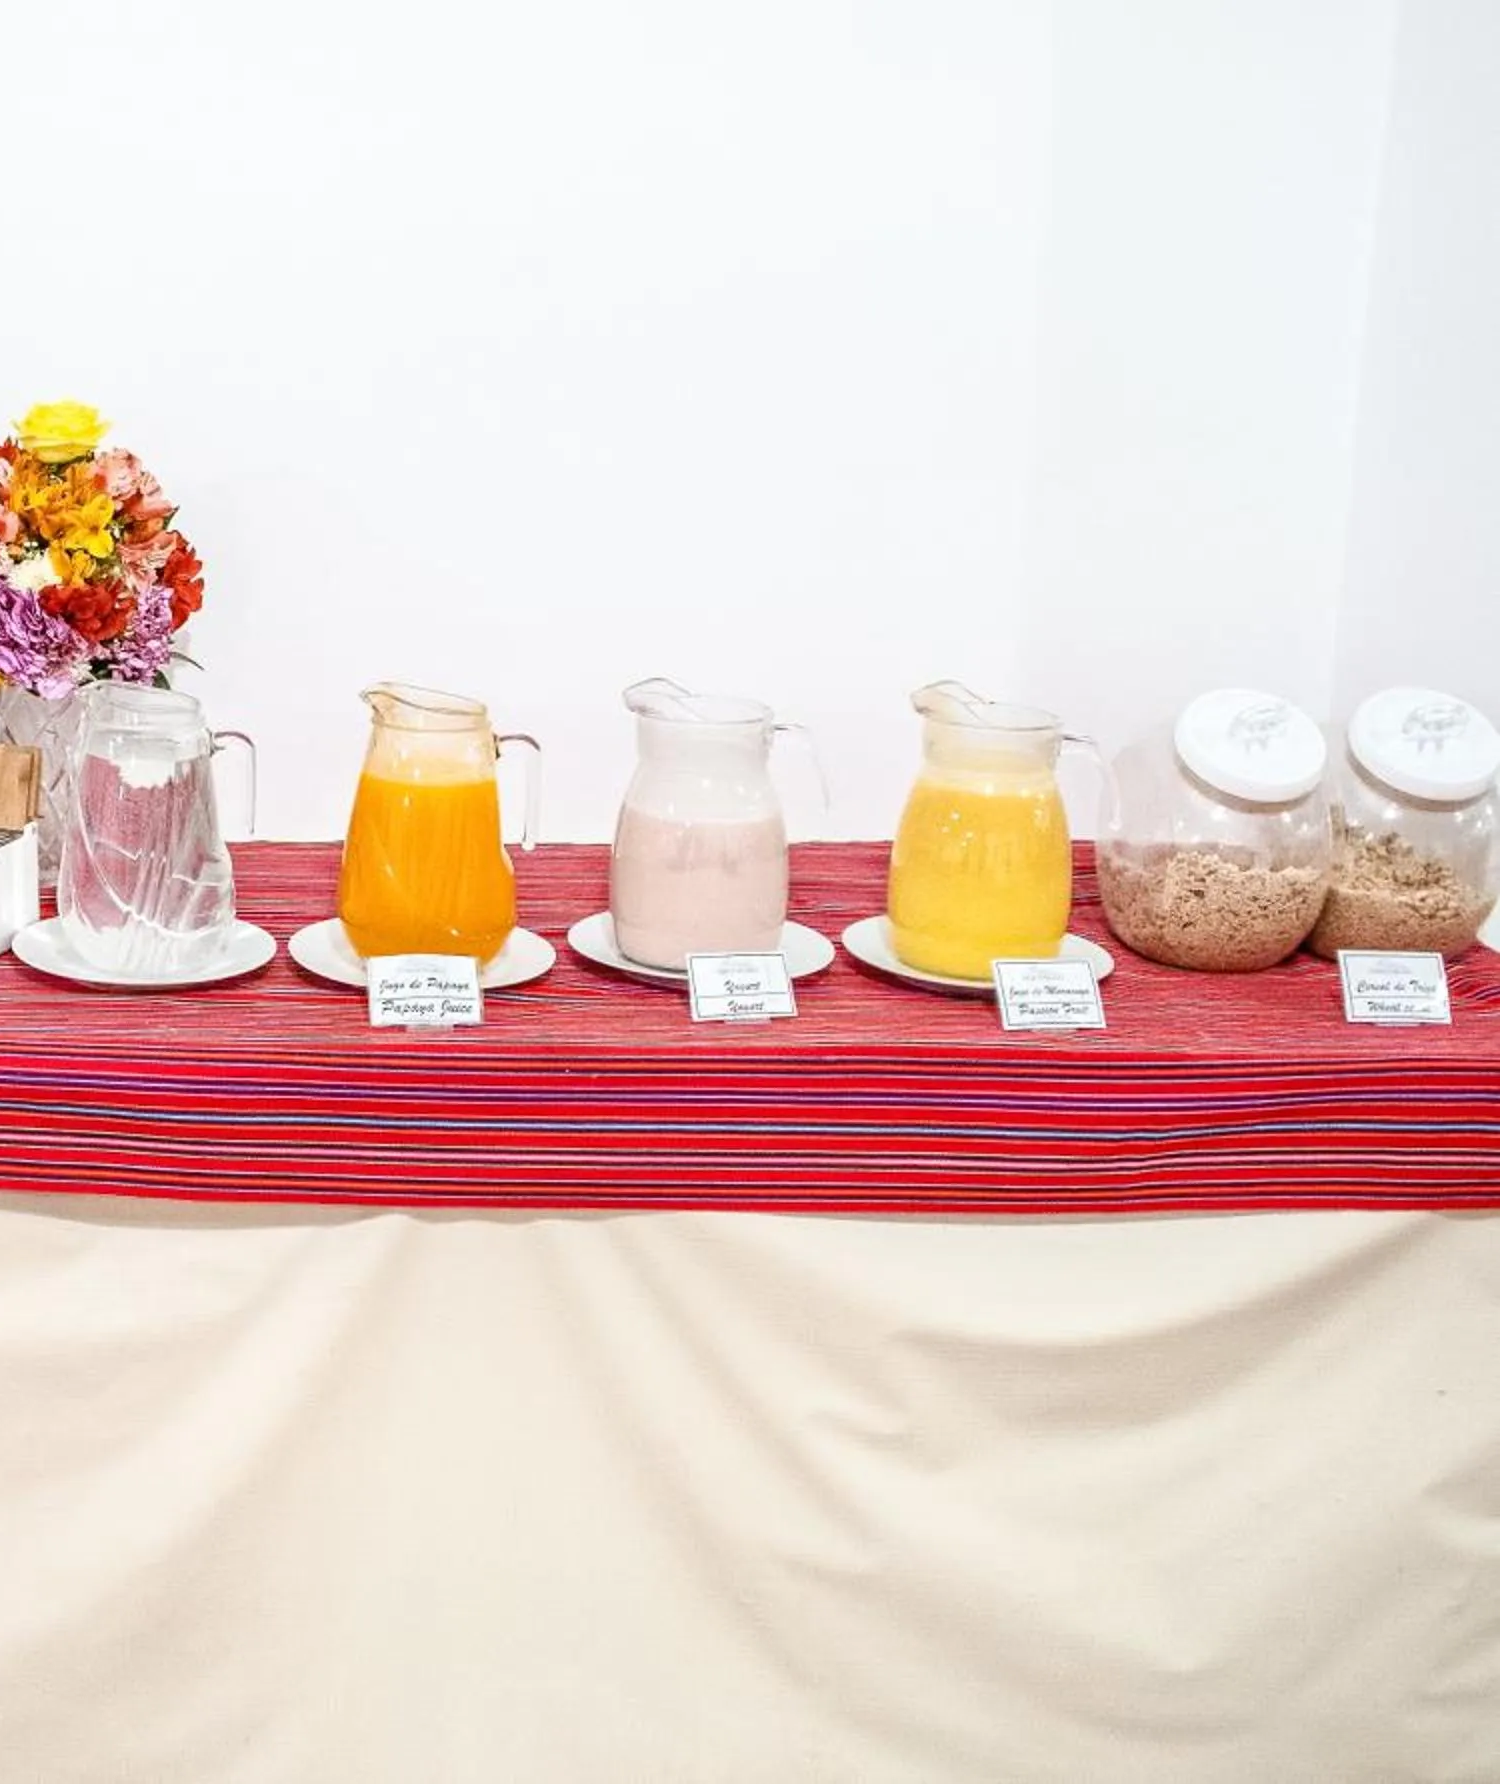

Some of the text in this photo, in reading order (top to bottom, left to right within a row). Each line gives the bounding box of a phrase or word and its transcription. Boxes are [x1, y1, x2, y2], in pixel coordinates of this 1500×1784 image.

[379, 977, 469, 995] Jugo de Papaya
[381, 999, 472, 1018] Papaya Juice
